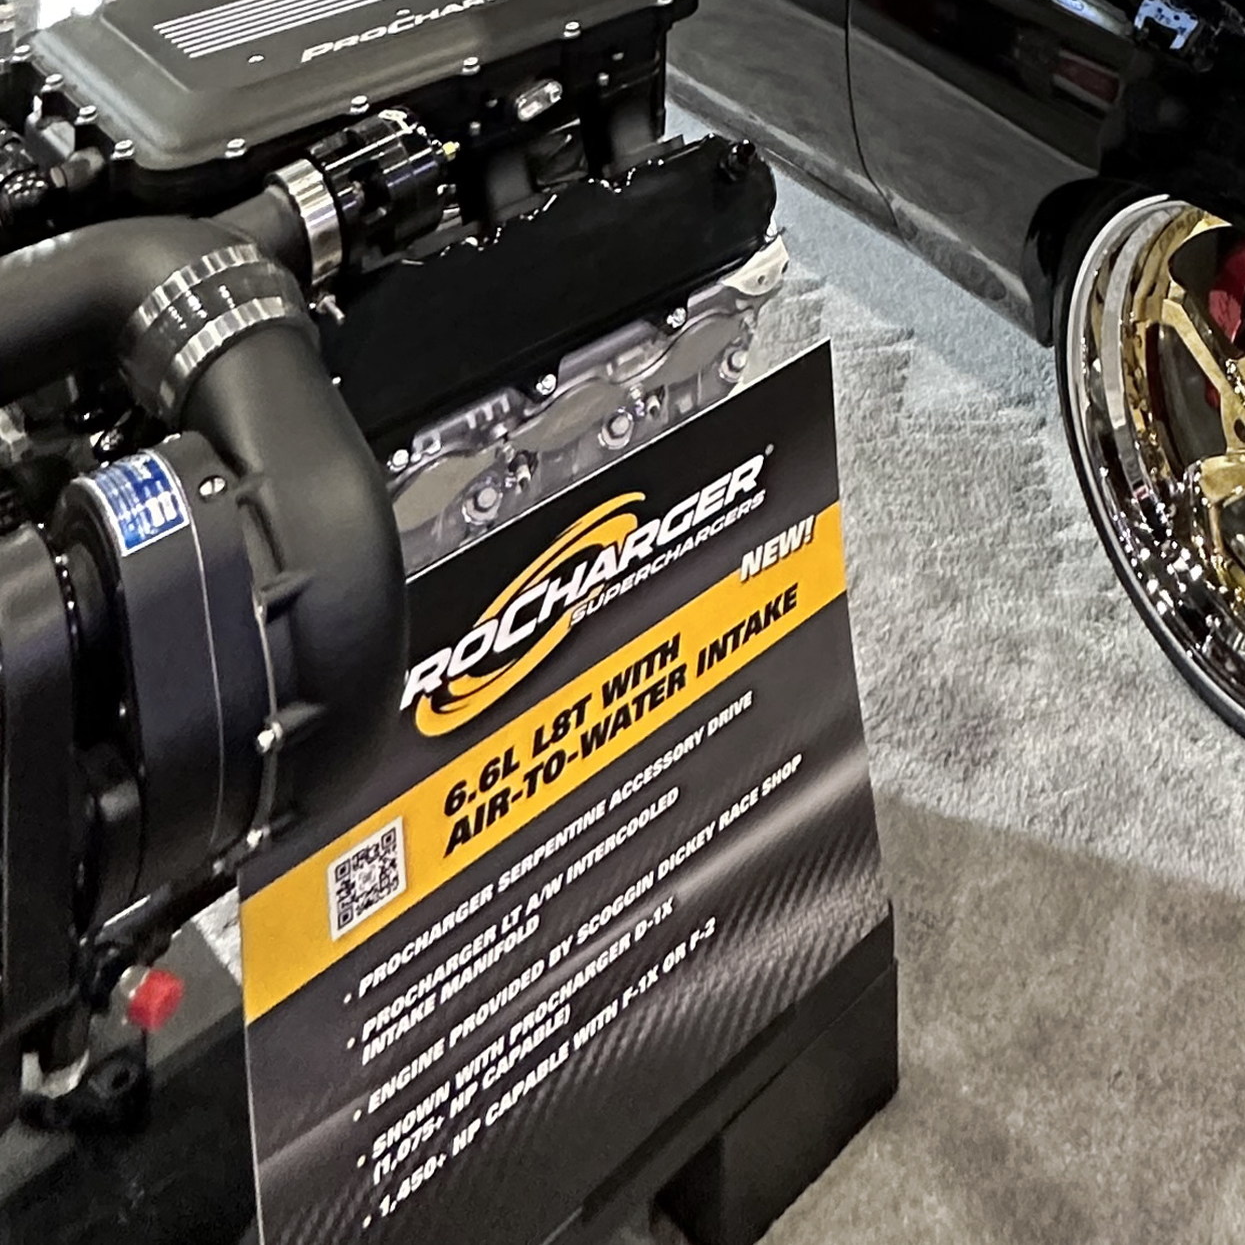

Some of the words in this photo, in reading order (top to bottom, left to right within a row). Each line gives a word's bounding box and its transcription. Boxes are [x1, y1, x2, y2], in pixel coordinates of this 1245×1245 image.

[400, 453, 766, 710] ROCHARGER
[569, 489, 766, 629] SUPERCHARGERS
[739, 514, 817, 583] NEW!
[358, 883, 493, 998] PROCHARGER
[497, 800, 607, 894] SERPENTINE
[608, 726, 706, 810] ACCESSORY
[707, 689, 754, 737] DRIVE
[443, 663, 688, 859] AIR-TO-WATER
[696, 582, 800, 679] INTAKE
[444, 745, 520, 818] 6.6L
[531, 693, 593, 758] L8T
[601, 633, 681, 711] WITH
[361, 925, 497, 1042] PROCHARGER
[500, 908, 522, 936] LT
[524, 880, 563, 917] A/W
[565, 786, 680, 888] INTERCOOLED
[362, 996, 436, 1066] INTAKE
[440, 913, 541, 1002] MANIFOLD
[367, 1043, 446, 1114] ENGINE
[448, 961, 544, 1046] PROVIDED
[547, 937, 573, 969] BY
[576, 865, 654, 943] SCOGGIN
[657, 825, 716, 885] DICKEY
[718, 789, 760, 832] RACE
[761, 754, 803, 796] SHOP
[371, 1080, 450, 1159] SHOWN
[454, 1042, 505, 1092] WITH
[509, 931, 632, 1046] PROCHARGER
[634, 897, 675, 944] D-1X
[373, 1116, 445, 1185] (1,075+
[449, 1086, 478, 1119] HP
[481, 1005, 571, 1090] CAPABLE)
[379, 1153, 447, 1218] 1,450+
[452, 1123, 481, 1155] HP
[485, 1045, 570, 1127] CAPABLE
[573, 1005, 619, 1052] WITH
[621, 970, 660, 1009] F-1X
[662, 941, 688, 975] OR
